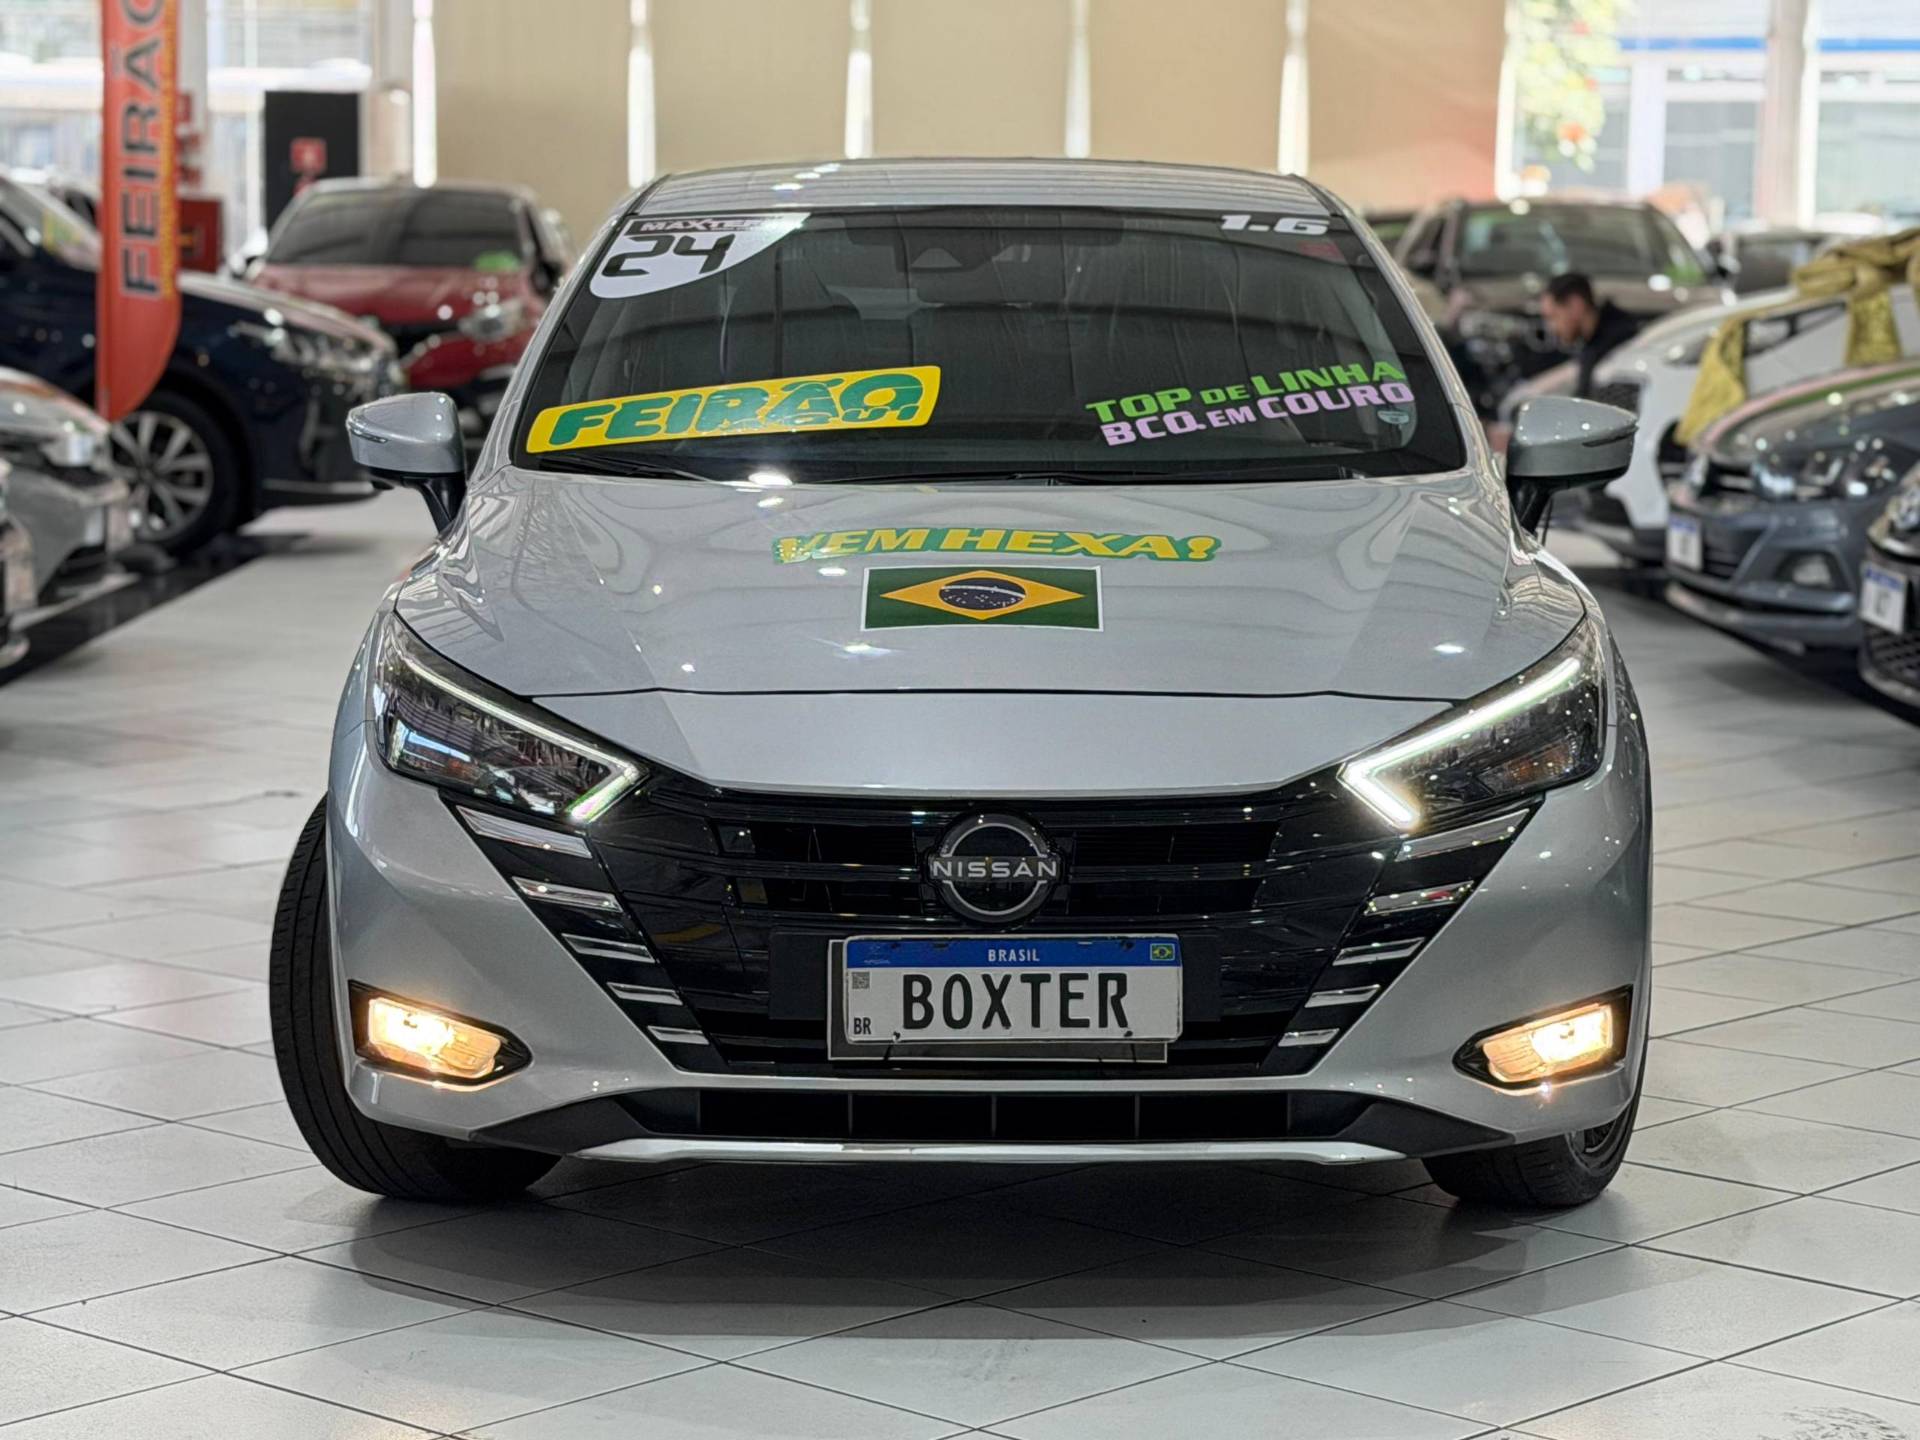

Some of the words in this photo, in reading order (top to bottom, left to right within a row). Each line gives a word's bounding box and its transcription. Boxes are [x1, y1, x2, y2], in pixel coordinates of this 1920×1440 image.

[1220, 214, 1331, 236] 1.6
[600, 233, 736, 278] 24
[547, 372, 925, 446] FEIRÃO
[1085, 387, 1192, 424] TOP
[1199, 384, 1250, 405] DE
[1251, 360, 1407, 396] LINHA
[1207, 404, 1258, 428] EM
[1257, 382, 1416, 420] COURO
[776, 527, 931, 563] VEM
[938, 528, 1219, 561] HEXA!
[932, 860, 1058, 879] NISSAN
[987, 948, 1041, 963] BRASIL
[902, 971, 1130, 1031] BOXTER
[853, 1016, 872, 1035] BR
